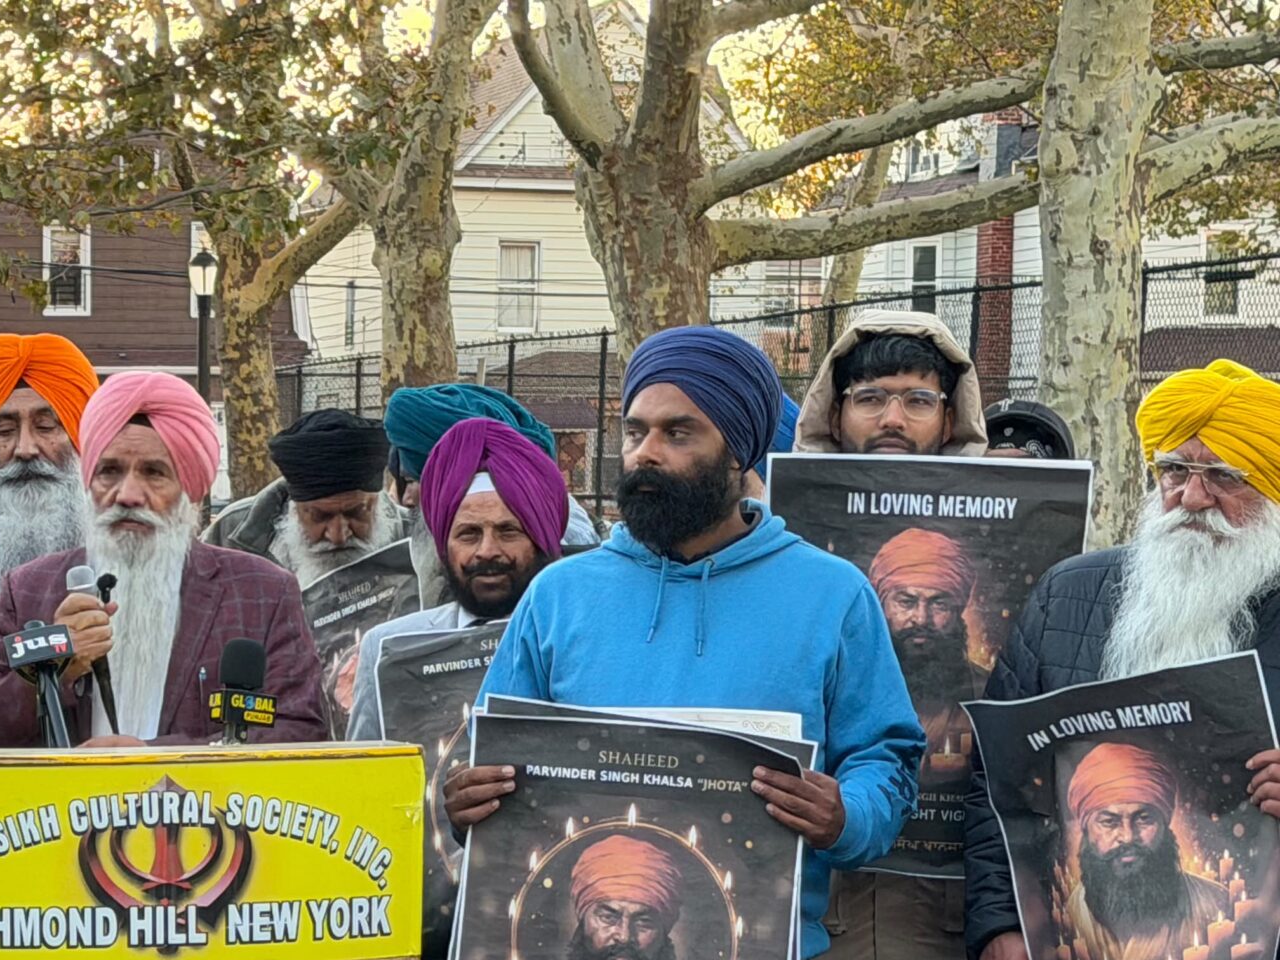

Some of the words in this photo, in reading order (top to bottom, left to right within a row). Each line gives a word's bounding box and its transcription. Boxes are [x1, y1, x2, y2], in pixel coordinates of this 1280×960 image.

[847, 492, 865, 514] IN
[870, 493, 933, 515] LOVING
[938, 495, 1018, 519] MEMORY
[11, 633, 68, 658] jus
[423, 659, 481, 675] PARVINDER
[231, 693, 275, 712] GLOBAL
[1027, 730, 1051, 752] IN
[1049, 710, 1117, 739] LOVING
[1116, 701, 1193, 728] MEMORY
[598, 750, 680, 769] SHAHEED
[525, 764, 596, 781] PARVINDER
[599, 770, 640, 784] SINGH
[643, 773, 694, 788] KHALSA
[69, 791, 216, 837] CULTURAL
[225, 792, 340, 856] SOCIETY,
[345, 826, 394, 889] INC.
[127, 903, 208, 947] HILL
[226, 901, 301, 945] NEW
[308, 895, 393, 940] YORK
